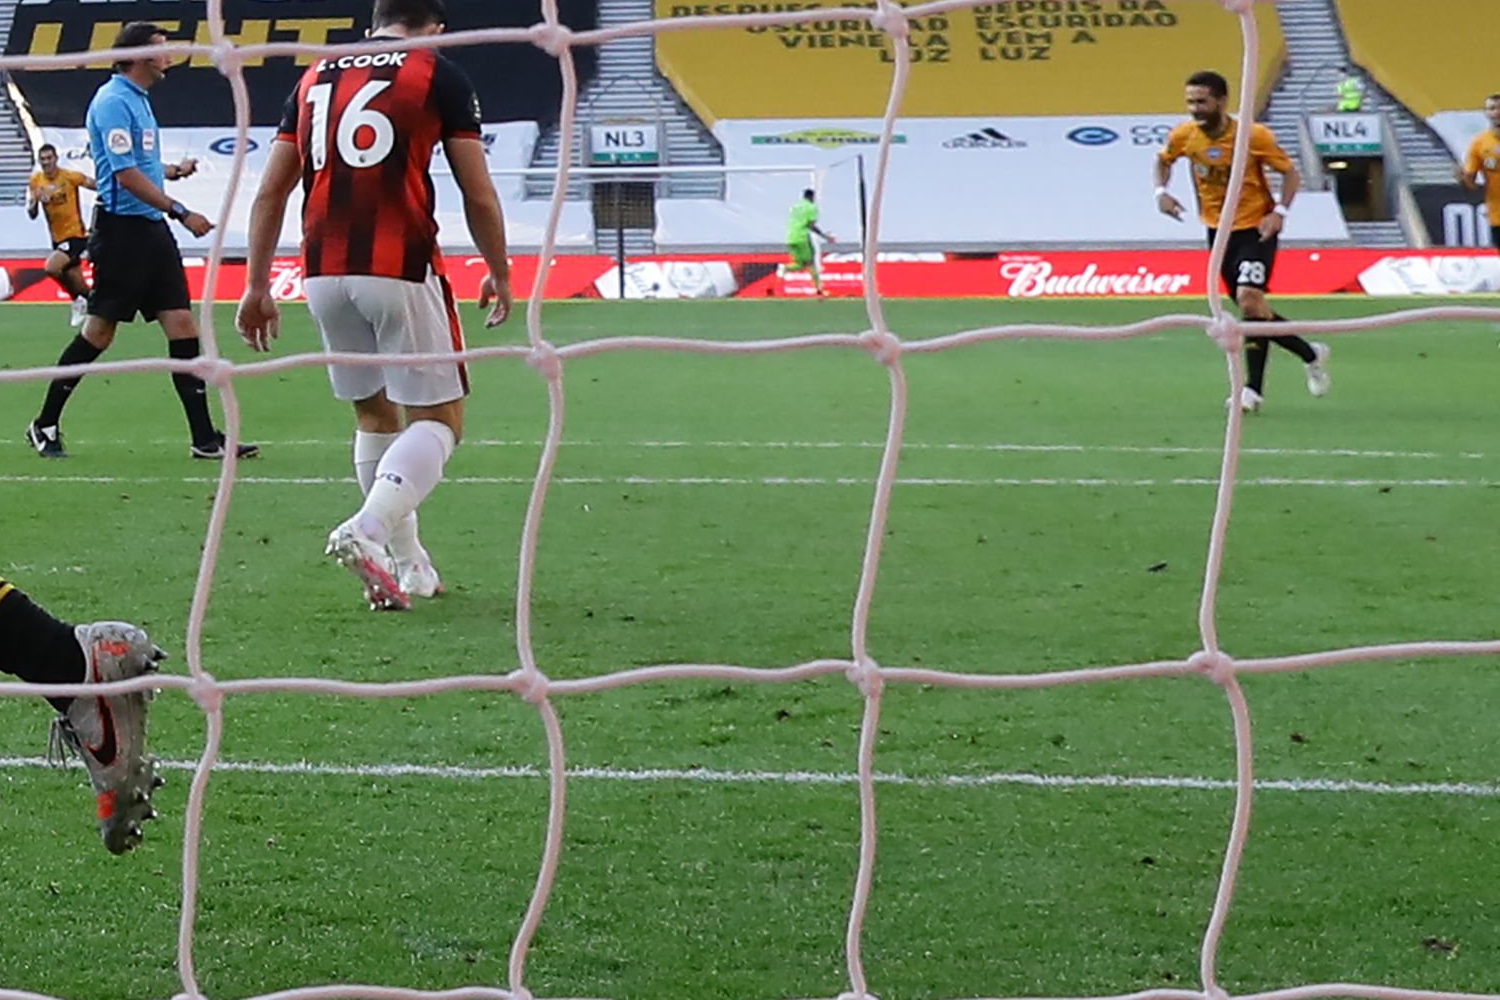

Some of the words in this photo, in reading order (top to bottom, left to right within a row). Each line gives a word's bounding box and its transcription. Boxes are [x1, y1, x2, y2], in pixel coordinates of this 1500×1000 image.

[746, 18, 950, 33] OSCURIAD
[975, 14, 1178, 29] ESCURIDAO
[778, 34, 884, 48] VIENE
[979, 32, 1053, 45] VEM
[1072, 31, 1097, 44] A
[980, 47, 1051, 61] LUZ
[306, 80, 395, 172] 16
[1322, 120, 1369, 139] NL4
[604, 130, 645, 147] NL3
[1000, 261, 1191, 297] Budweiser
[1236, 260, 1266, 285] 28
